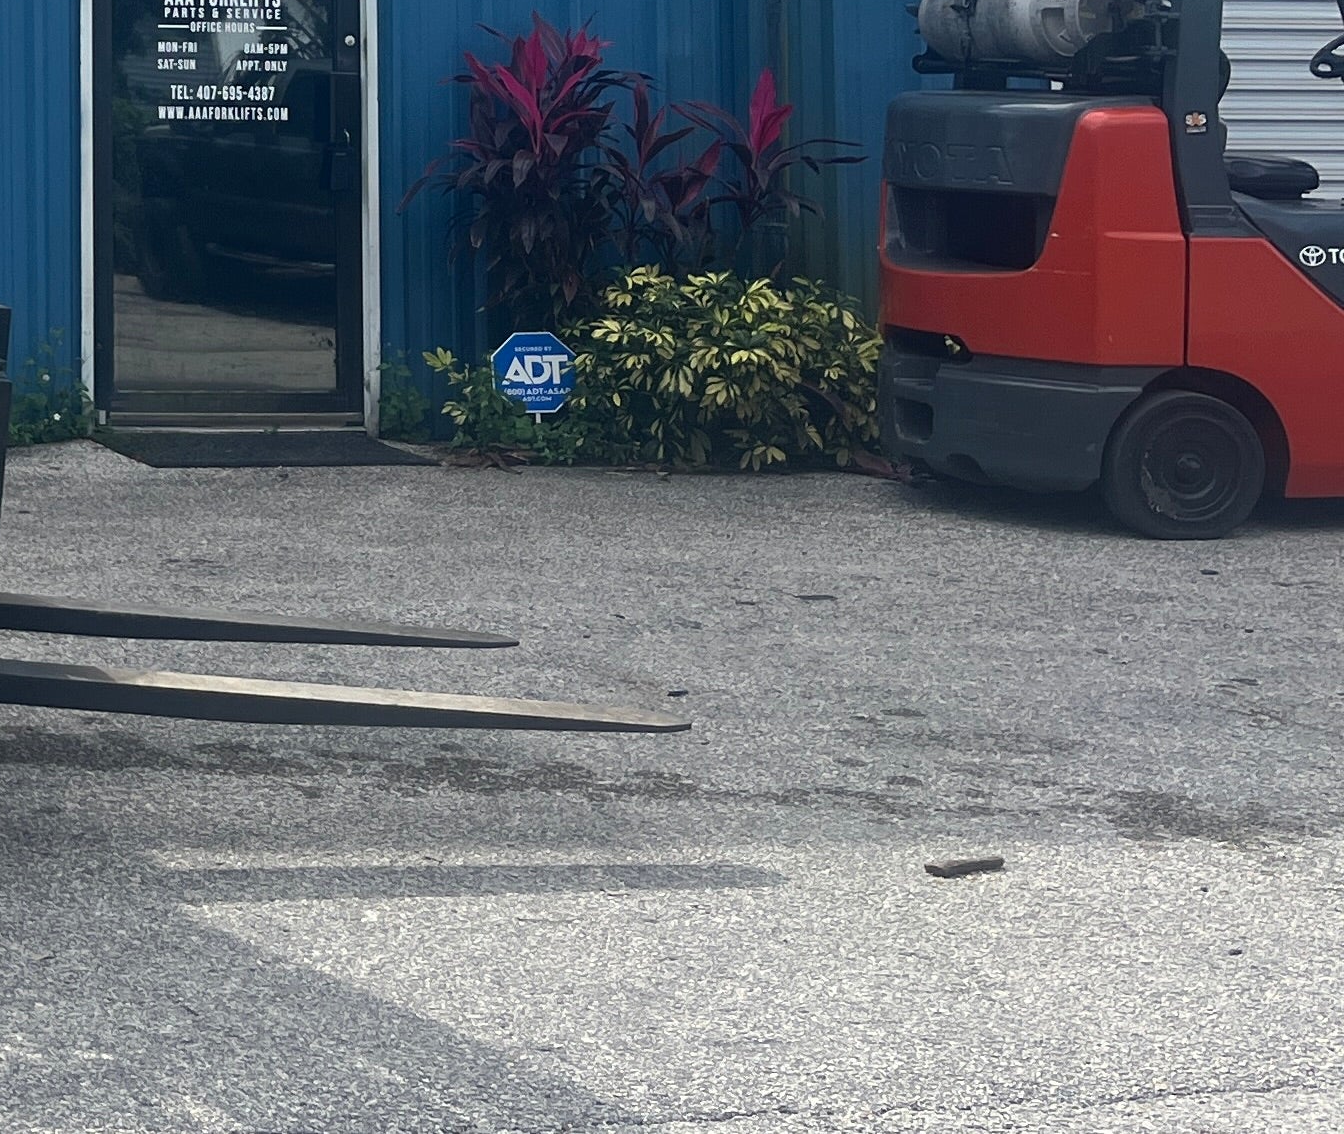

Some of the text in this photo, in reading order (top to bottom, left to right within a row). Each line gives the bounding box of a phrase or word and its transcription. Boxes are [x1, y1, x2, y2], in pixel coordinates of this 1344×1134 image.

[164, 6, 282, 20] PARTS & SERVICE
[189, 21, 256, 33] OFFICE HOURS
[157, 41, 289, 55] MON-FRI 8AM-5PM
[157, 58, 288, 72] SAT-SUN APPT. ONLY
[170, 84, 276, 102] TEL: 407-695-4387
[157, 105, 289, 122] WWW.AAAFORKLIFTS.COM
[501, 354, 568, 385] ADT
